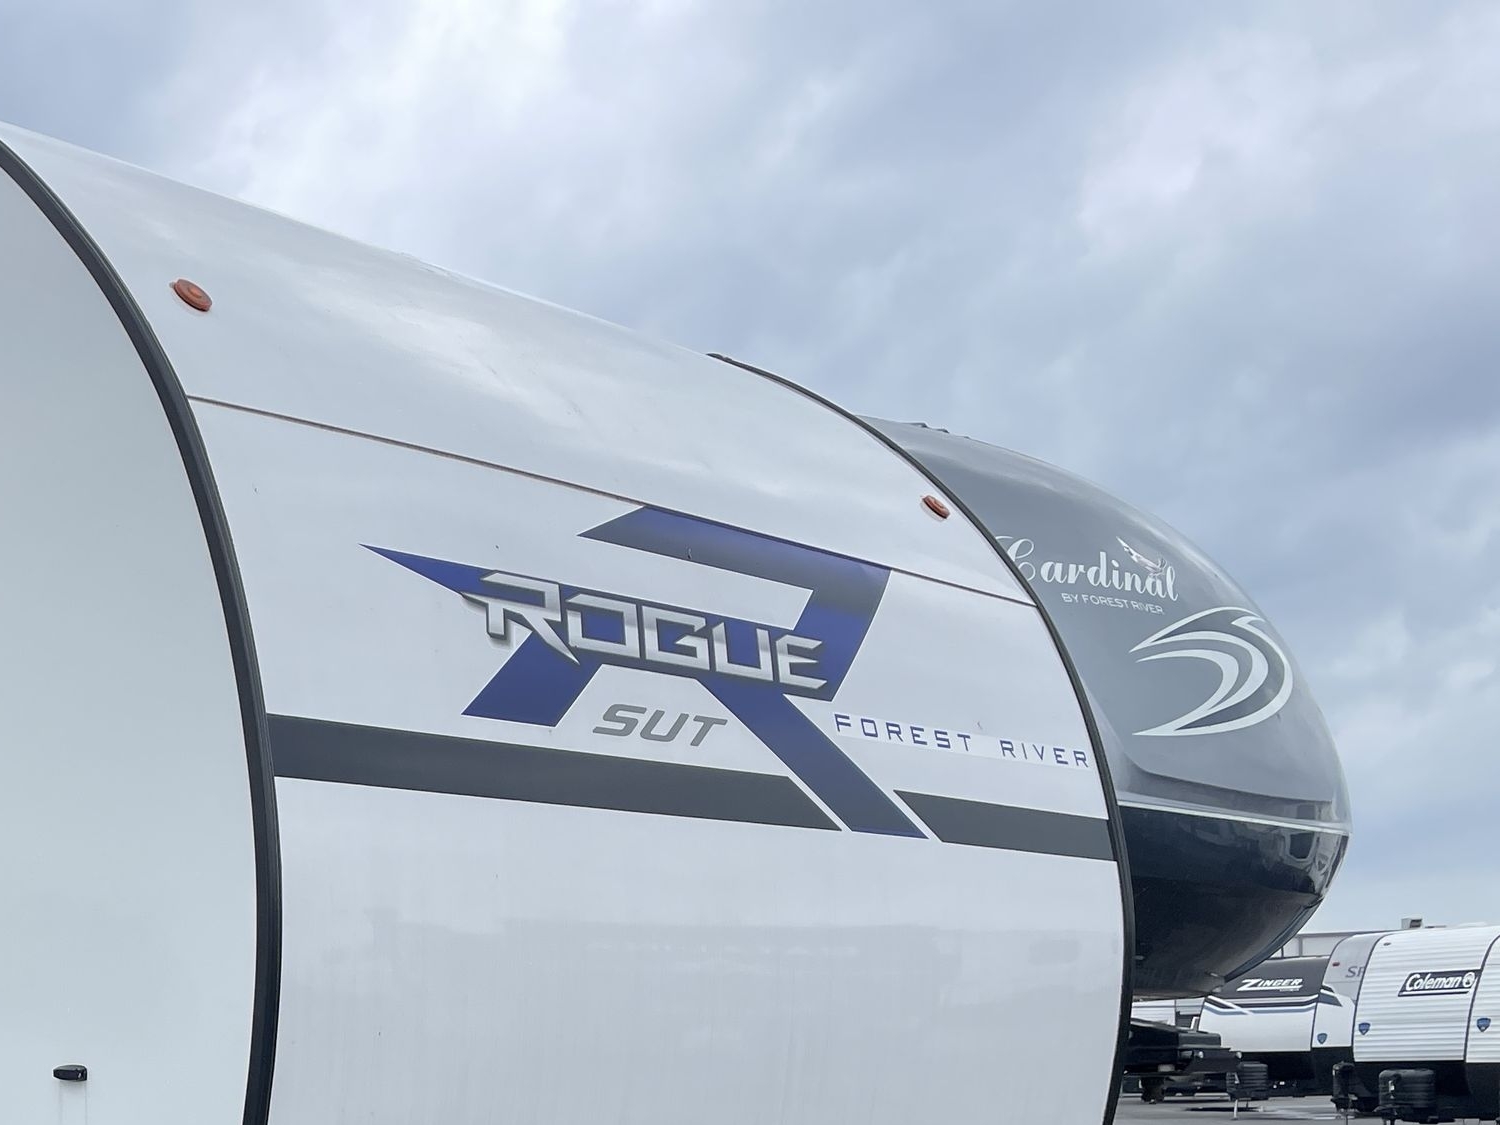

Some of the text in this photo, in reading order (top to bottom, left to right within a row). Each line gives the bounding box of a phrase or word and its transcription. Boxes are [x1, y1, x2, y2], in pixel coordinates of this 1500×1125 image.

[996, 536, 1179, 602] Cardinal
[1060, 592, 1166, 616] BY FOREST RIVER
[461, 572, 828, 690] ROGUE
[592, 703, 729, 747] SUT
[834, 713, 1089, 768] FOREST RIVER
[1405, 973, 1463, 991] Coleman
